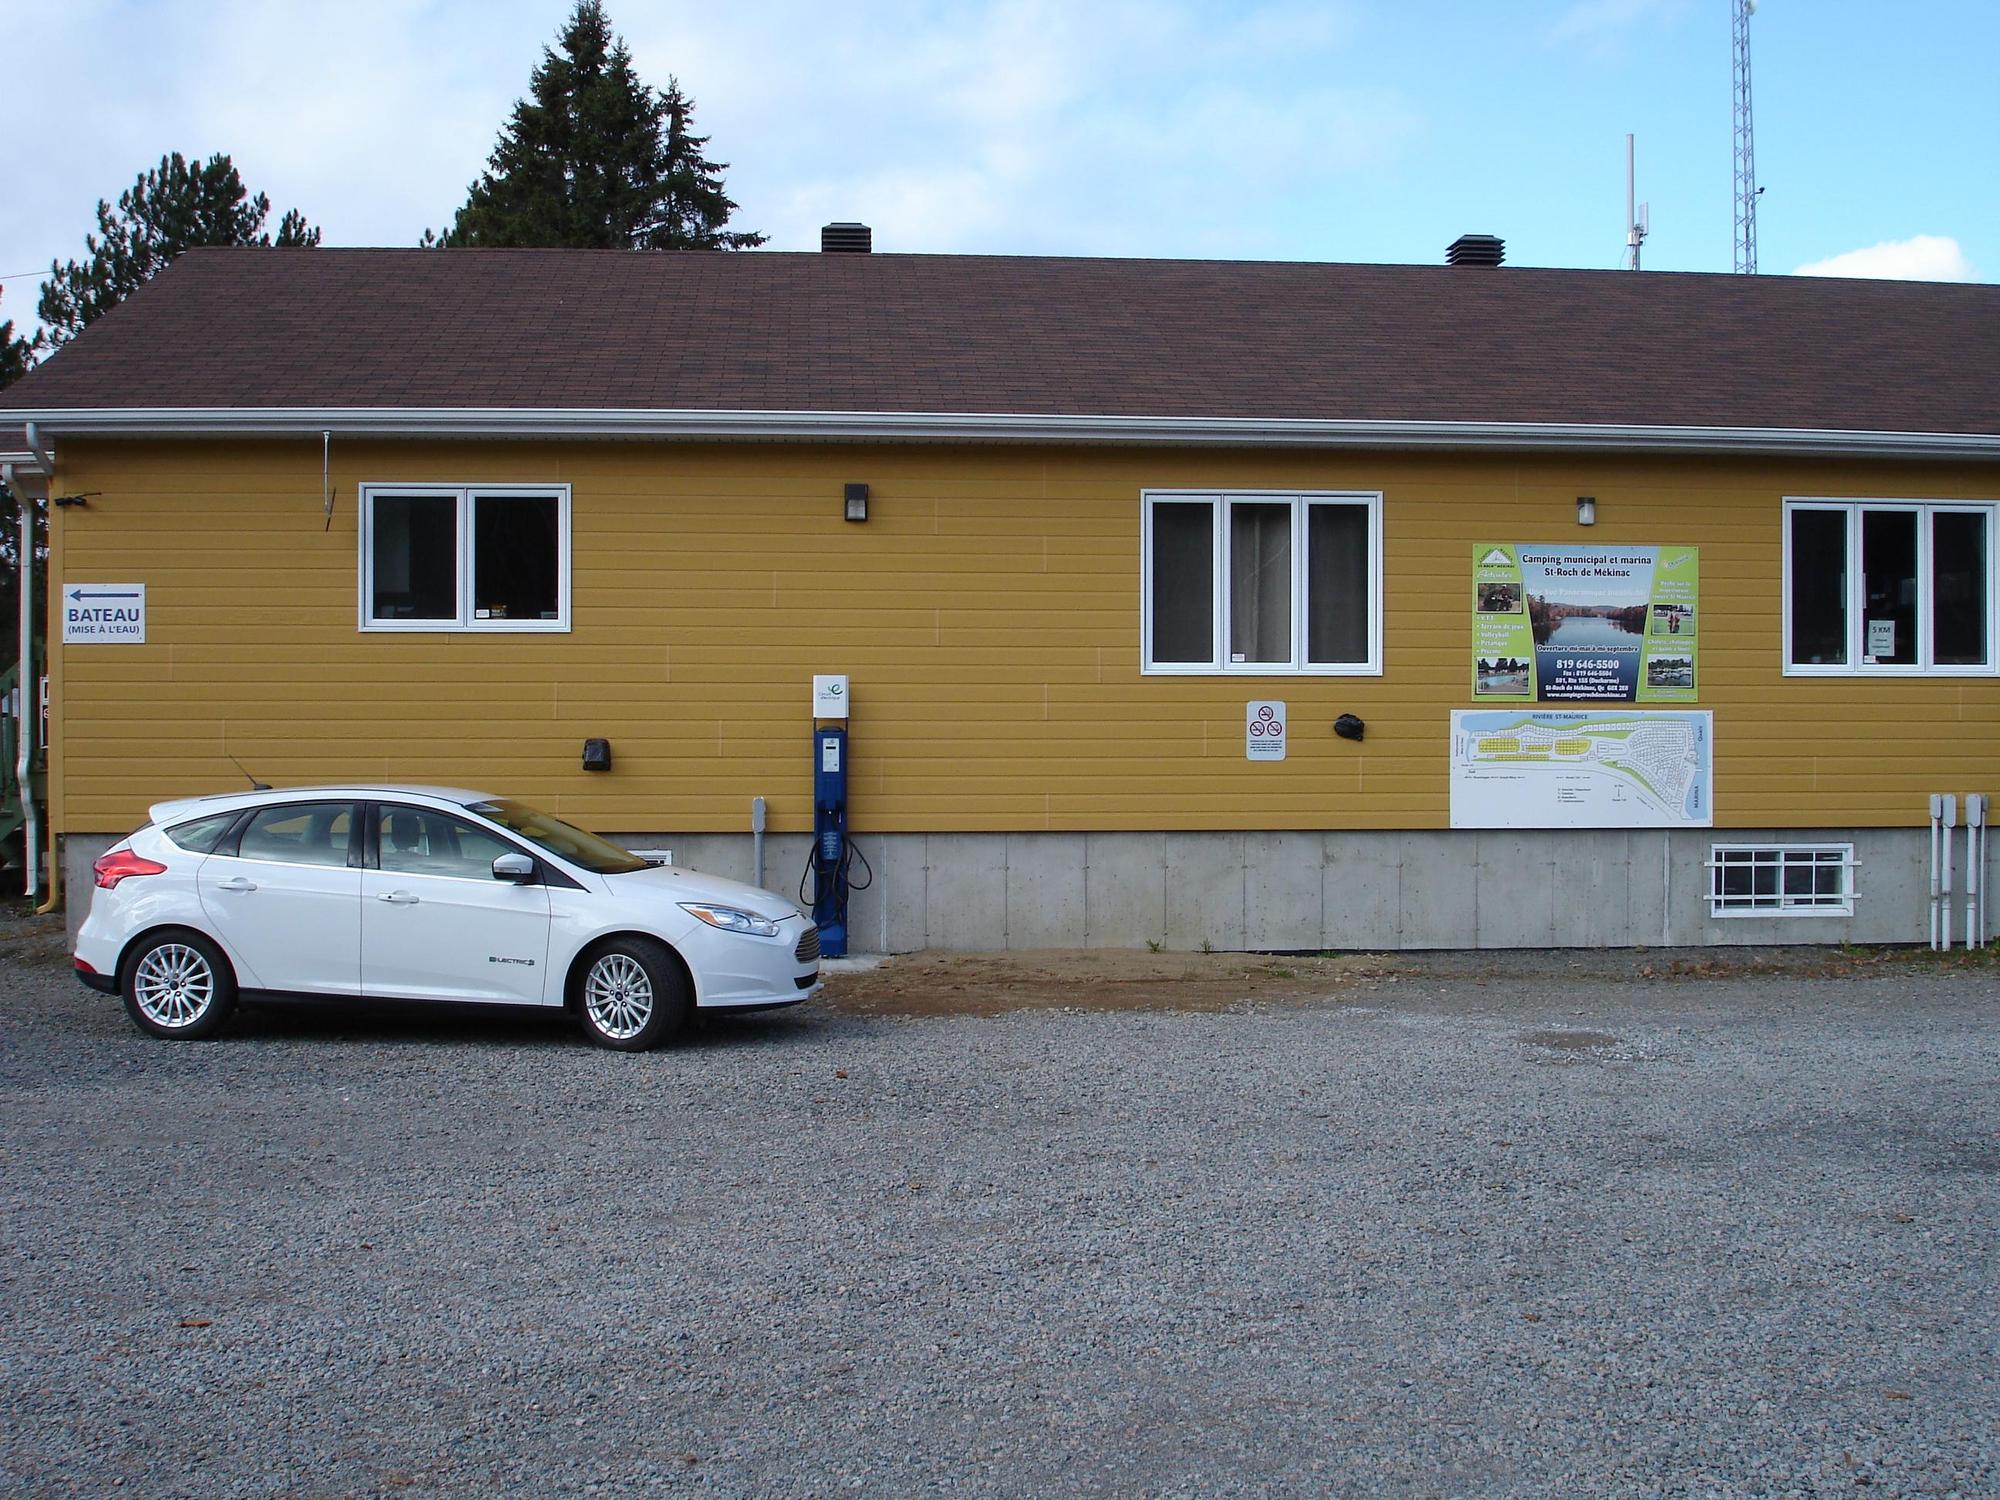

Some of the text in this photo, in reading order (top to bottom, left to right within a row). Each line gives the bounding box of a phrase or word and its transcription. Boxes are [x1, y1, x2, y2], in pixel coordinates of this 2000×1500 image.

[1522, 555, 1652, 566] Camping municipal et marina
[1544, 568, 1631, 577] St-Roch de Mékinac
[68, 608, 140, 622] BATEAU
[68, 624, 140, 635] (MISE À L'EAU)
[1556, 659, 1620, 669] 819 646-5500
